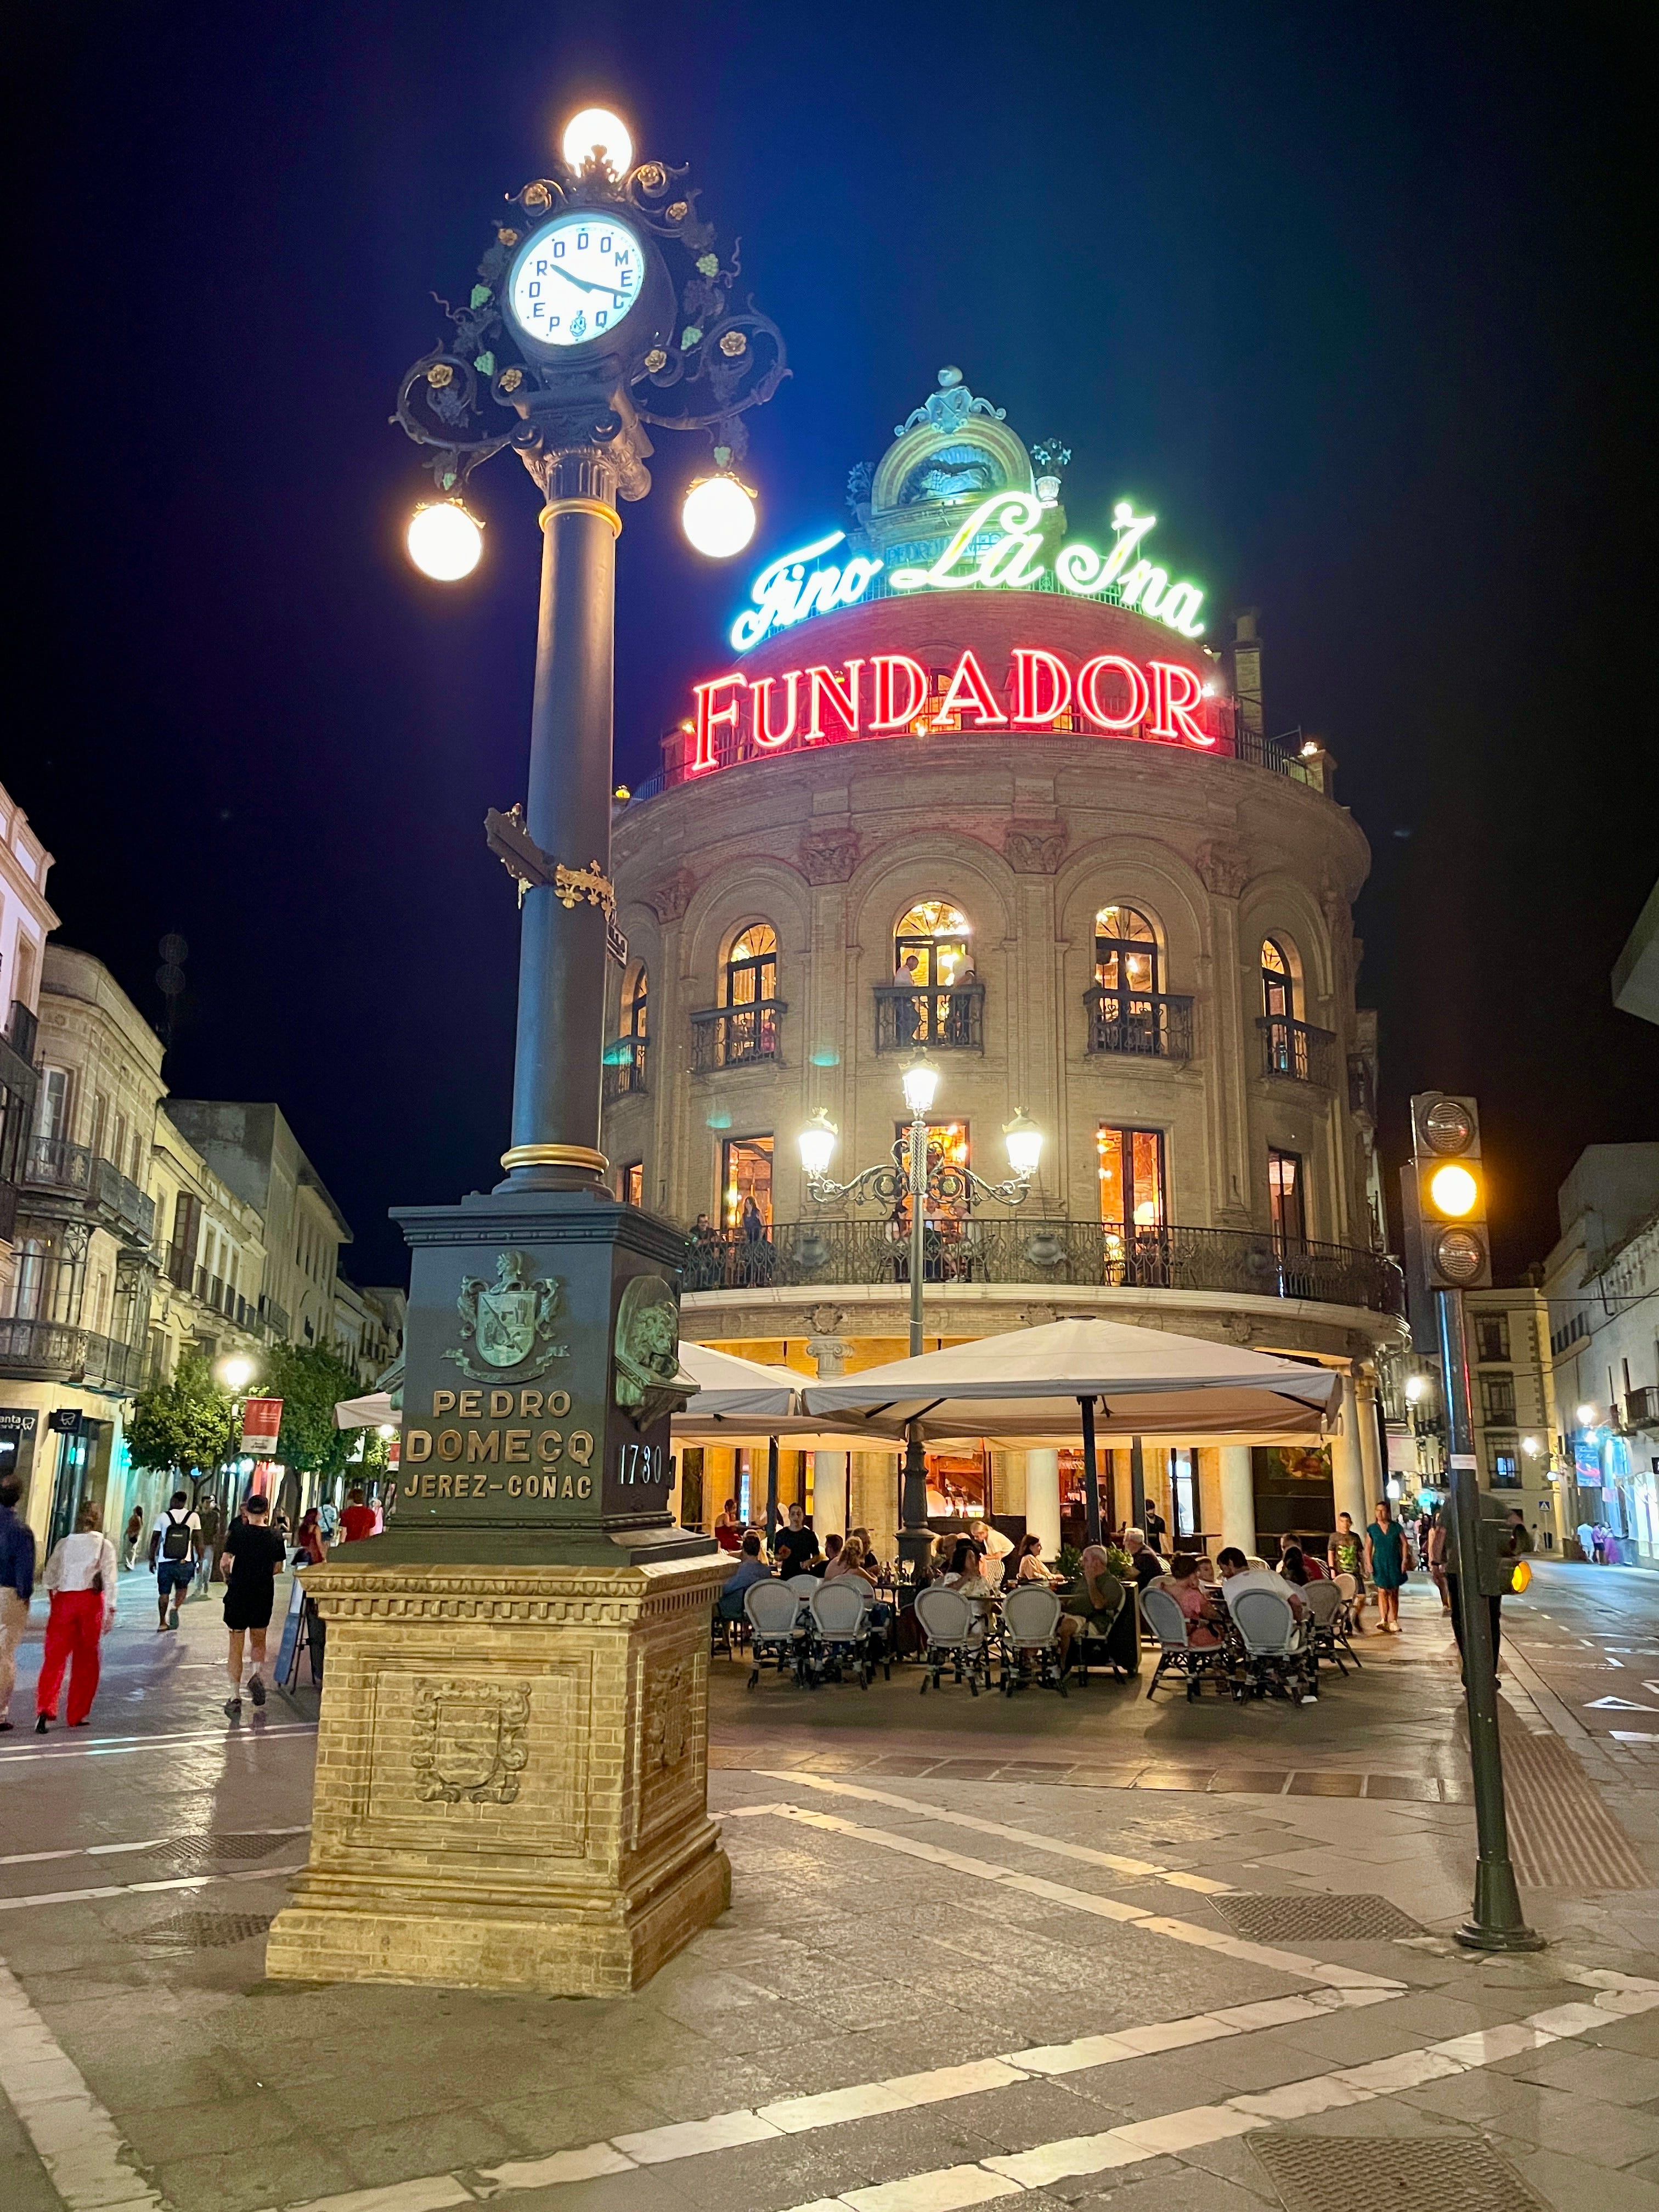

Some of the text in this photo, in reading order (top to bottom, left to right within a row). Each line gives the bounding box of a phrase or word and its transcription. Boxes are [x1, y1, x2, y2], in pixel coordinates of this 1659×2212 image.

[731, 490, 1206, 651] Fino La Ina
[691, 649, 1216, 770] FUNDADOR
[433, 1390, 571, 1418] PEDRO
[405, 1429, 594, 1468] DOMECQ
[620, 1444, 662, 1485] 1730
